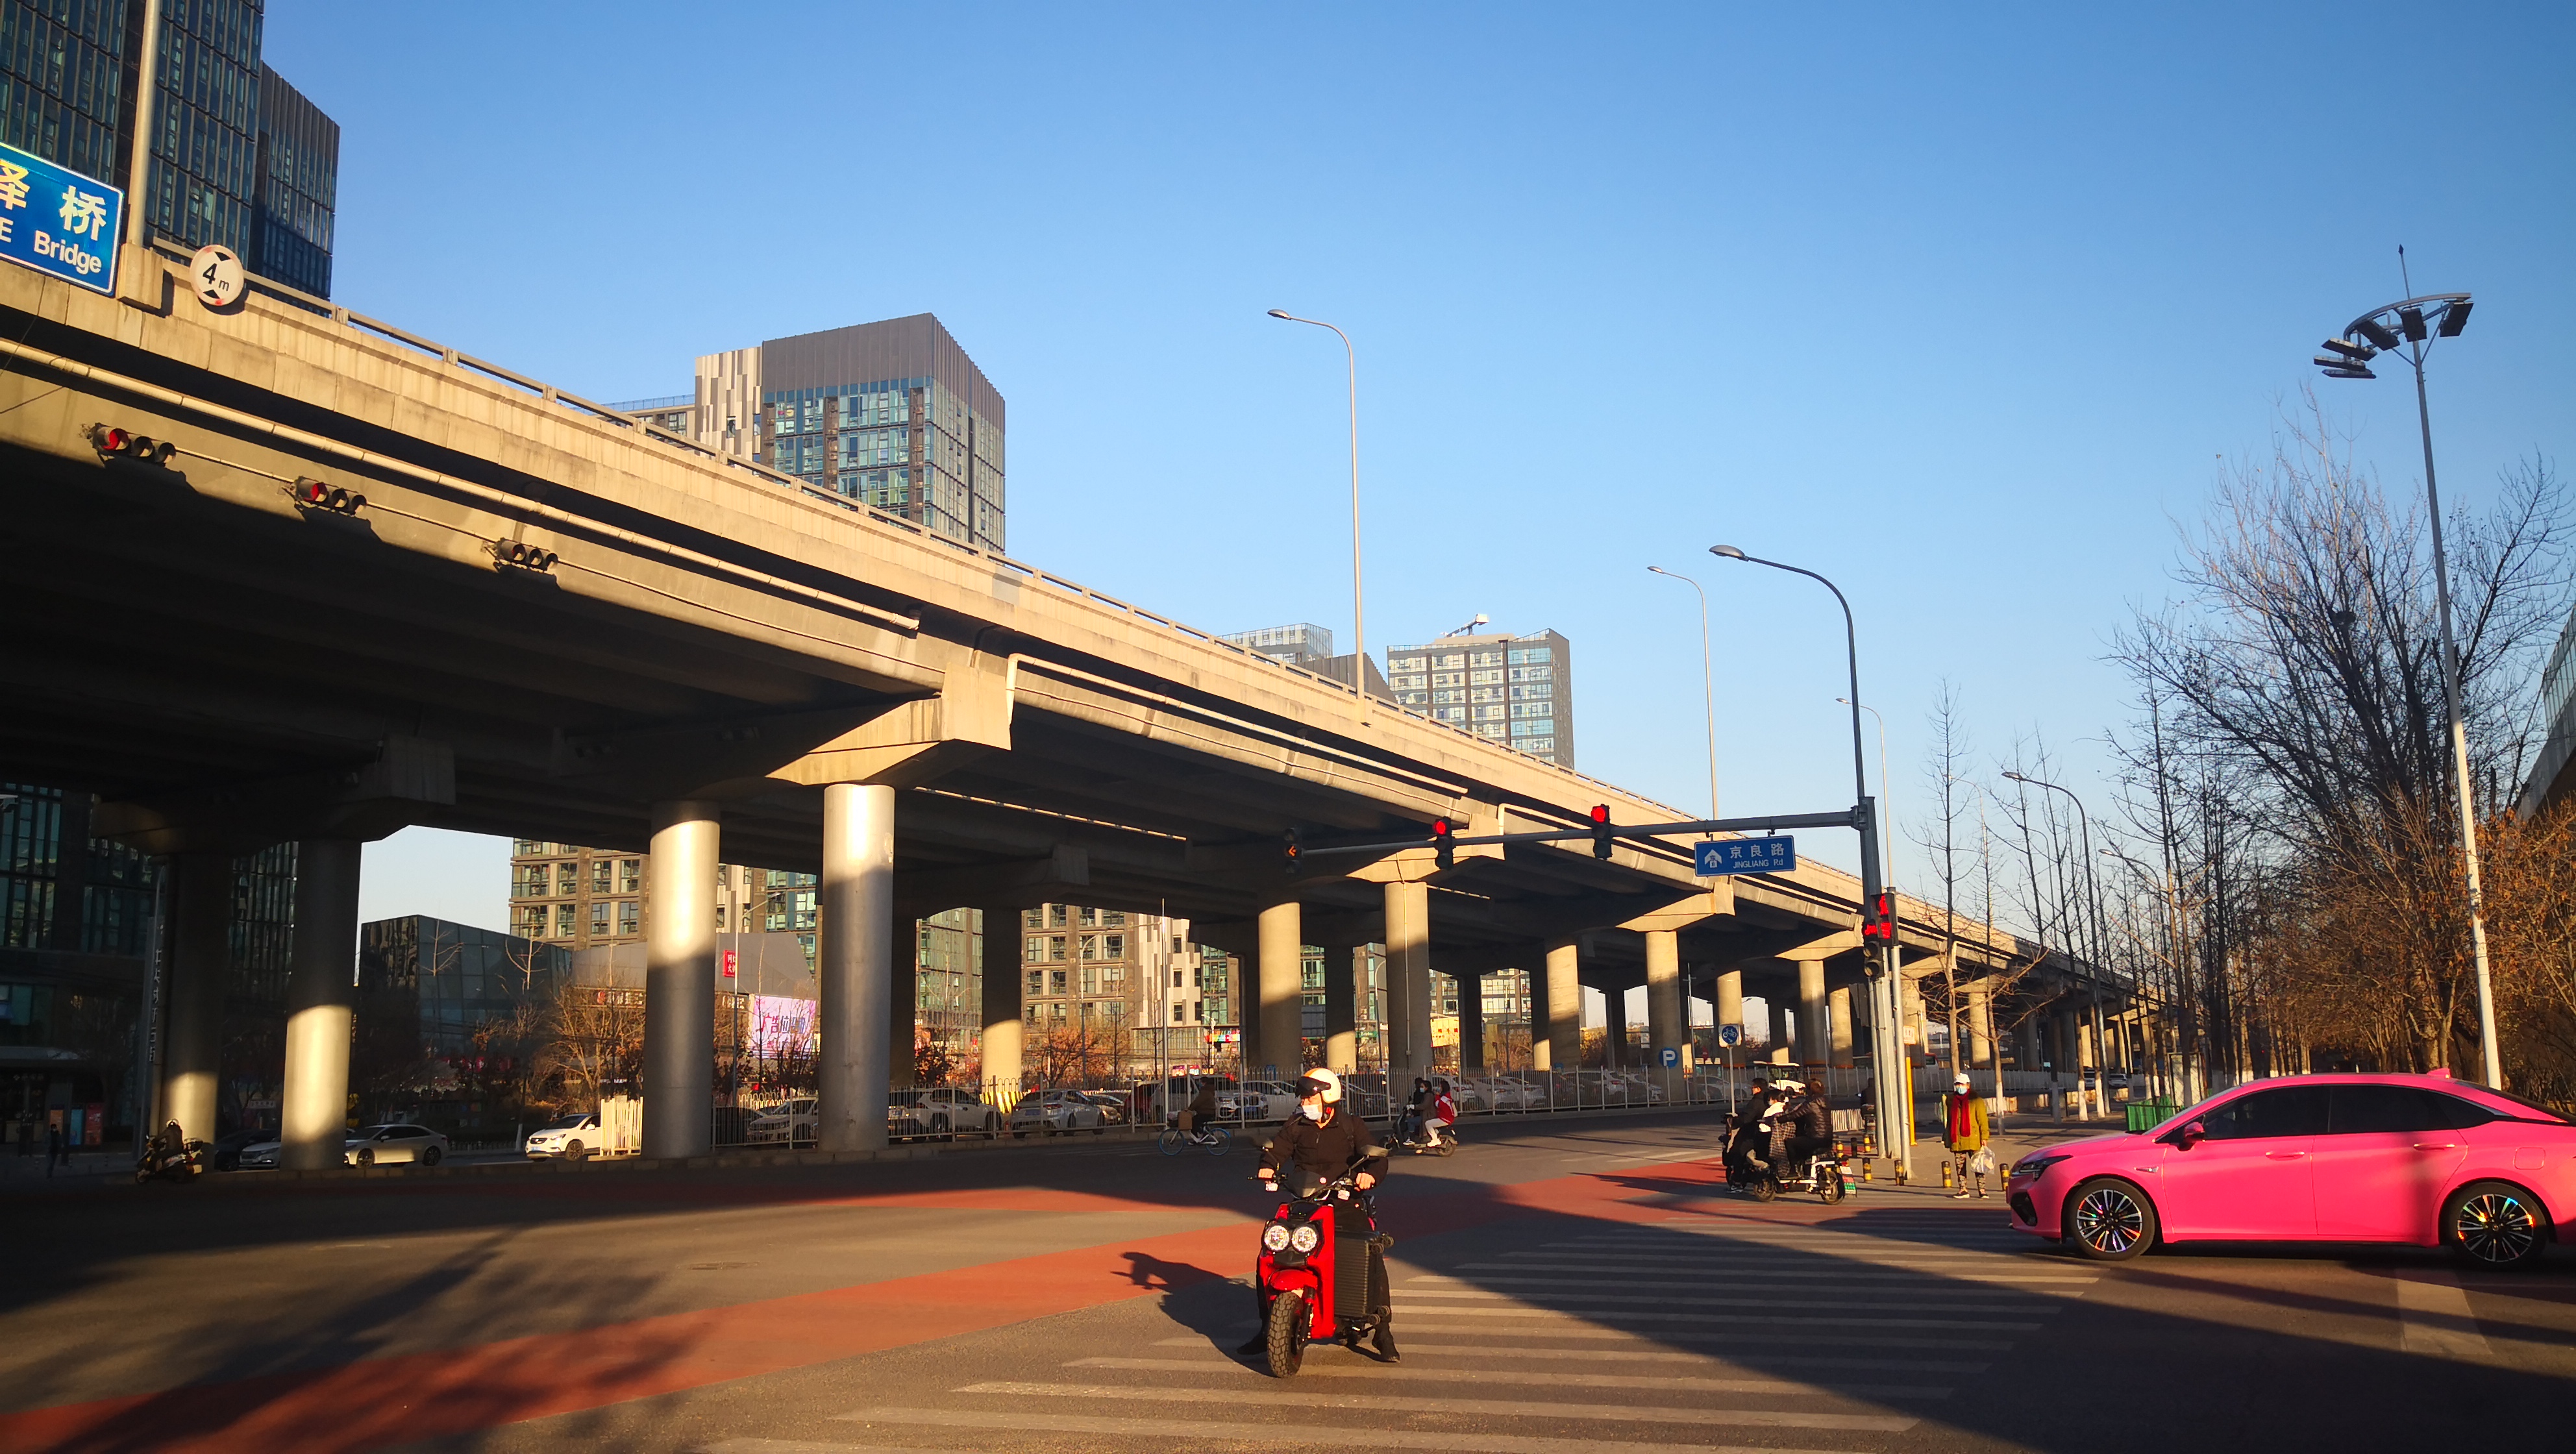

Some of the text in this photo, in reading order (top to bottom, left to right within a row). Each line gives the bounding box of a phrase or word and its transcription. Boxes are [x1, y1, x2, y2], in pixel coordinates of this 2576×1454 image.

[34, 230, 101, 275] Bridge
[1729, 843, 1785, 859] 京良路
[1733, 859, 1769, 869] JINGLIANG
[1663, 1051, 1676, 1066] P
